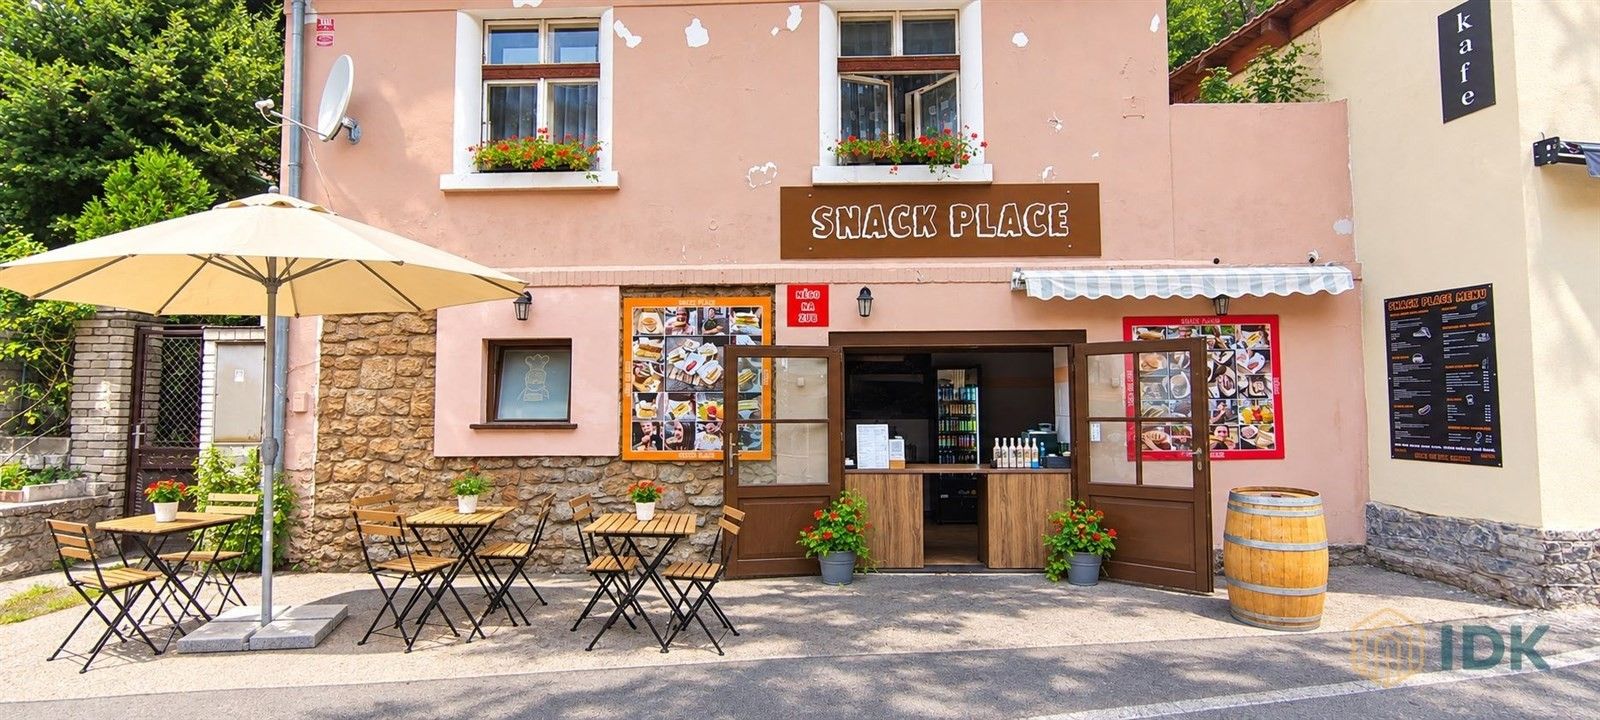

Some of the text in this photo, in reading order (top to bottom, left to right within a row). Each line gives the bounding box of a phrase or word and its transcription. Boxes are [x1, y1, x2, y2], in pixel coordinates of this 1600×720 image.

[1456, 12, 1475, 106] kafe
[811, 202, 1069, 239] SNACK PLACE
[795, 288, 821, 300] NĚGO
[1388, 288, 1488, 312] SNACK PLACE MENU
[800, 301, 815, 311] NA
[798, 313, 818, 323] ZUB
